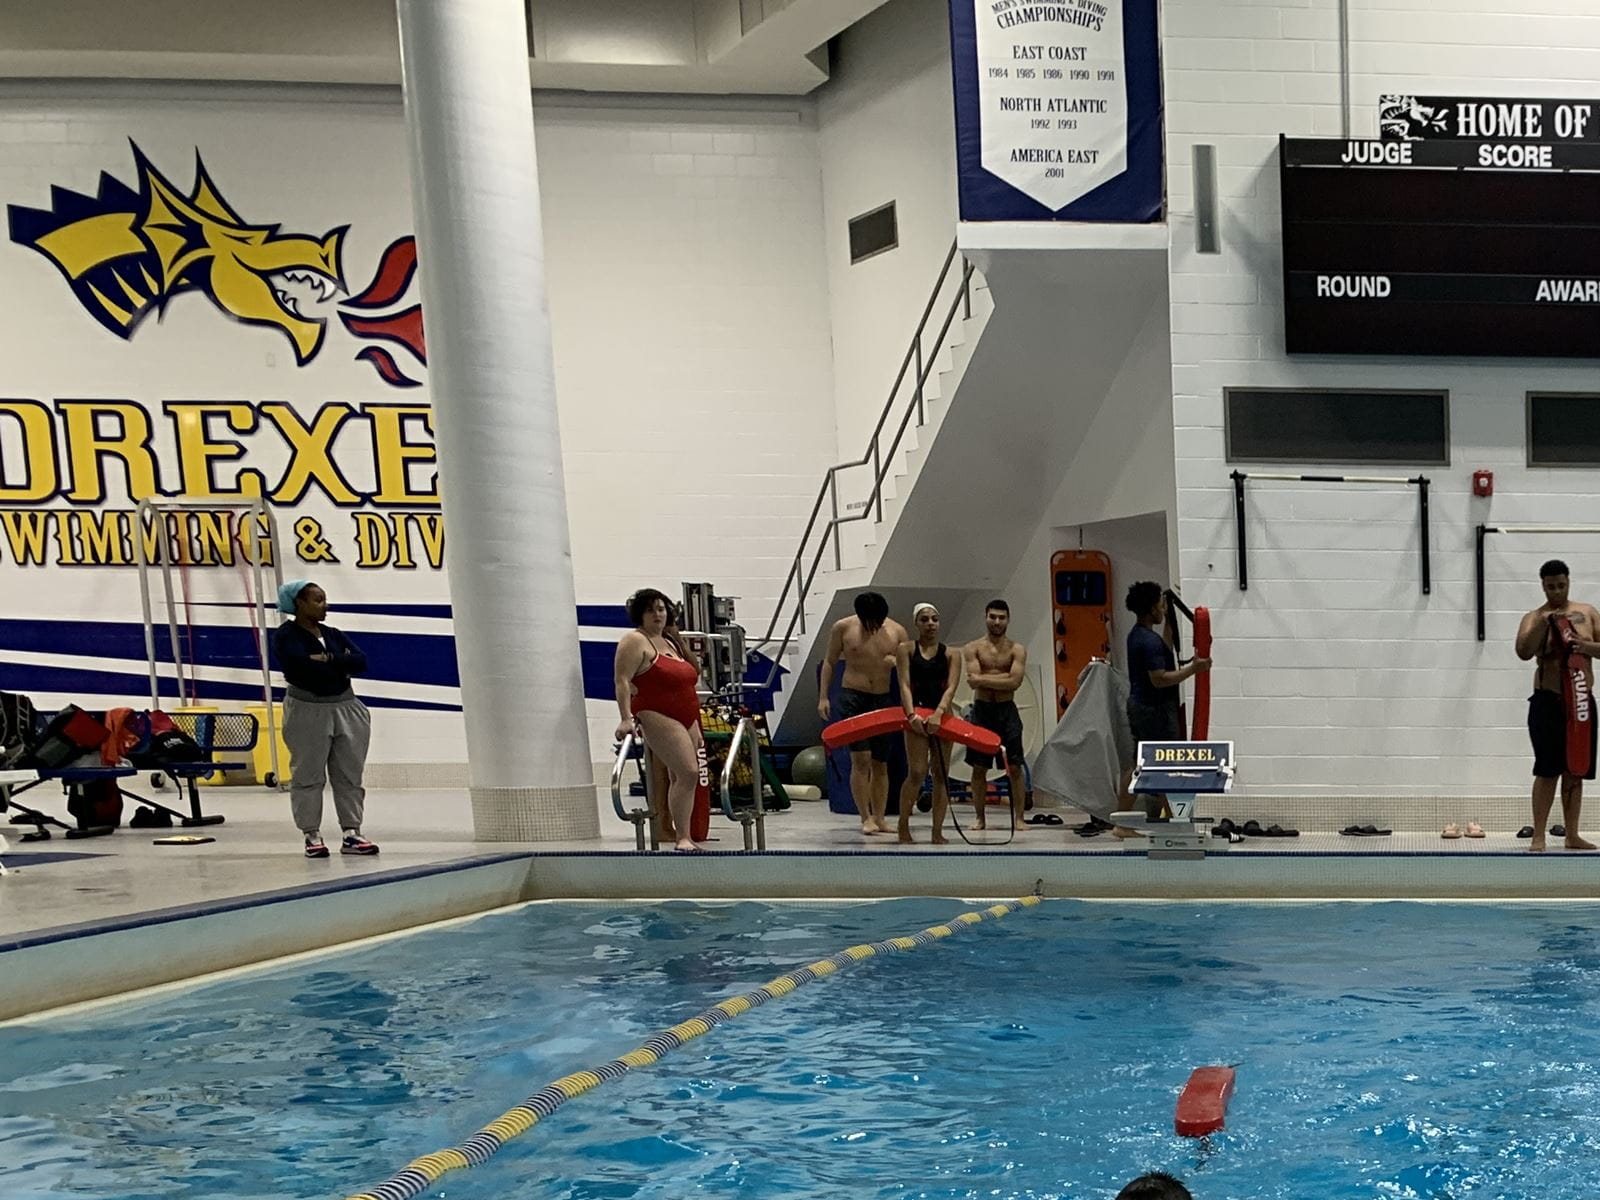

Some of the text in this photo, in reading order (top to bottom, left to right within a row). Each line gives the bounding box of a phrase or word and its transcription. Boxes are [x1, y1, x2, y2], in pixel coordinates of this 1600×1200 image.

[1078, 0, 1108, 17] DIVING
[996, 6, 1104, 32] CHAMPIONSHIPS
[1013, 45, 1088, 61] EAST COAST
[989, 68, 1115, 81] 1984 1985 1986 1990 1991
[1000, 97, 1108, 113] NORTH ATLANTIC
[1031, 119, 1077, 130] 1992 1993
[1456, 103, 1542, 137] HOME
[1554, 105, 1591, 138] OF
[1010, 149, 1099, 164] AMERICA EAST
[1341, 142, 1552, 167] JUDGE SCORE
[1045, 168, 1065, 178] 2001
[1317, 275, 1391, 297] ROUND
[0, 508, 276, 567] WIMMING
[294, 516, 340, 563] &
[1155, 748, 1216, 762] DREXEL
[1176, 803, 1186, 817] 7
